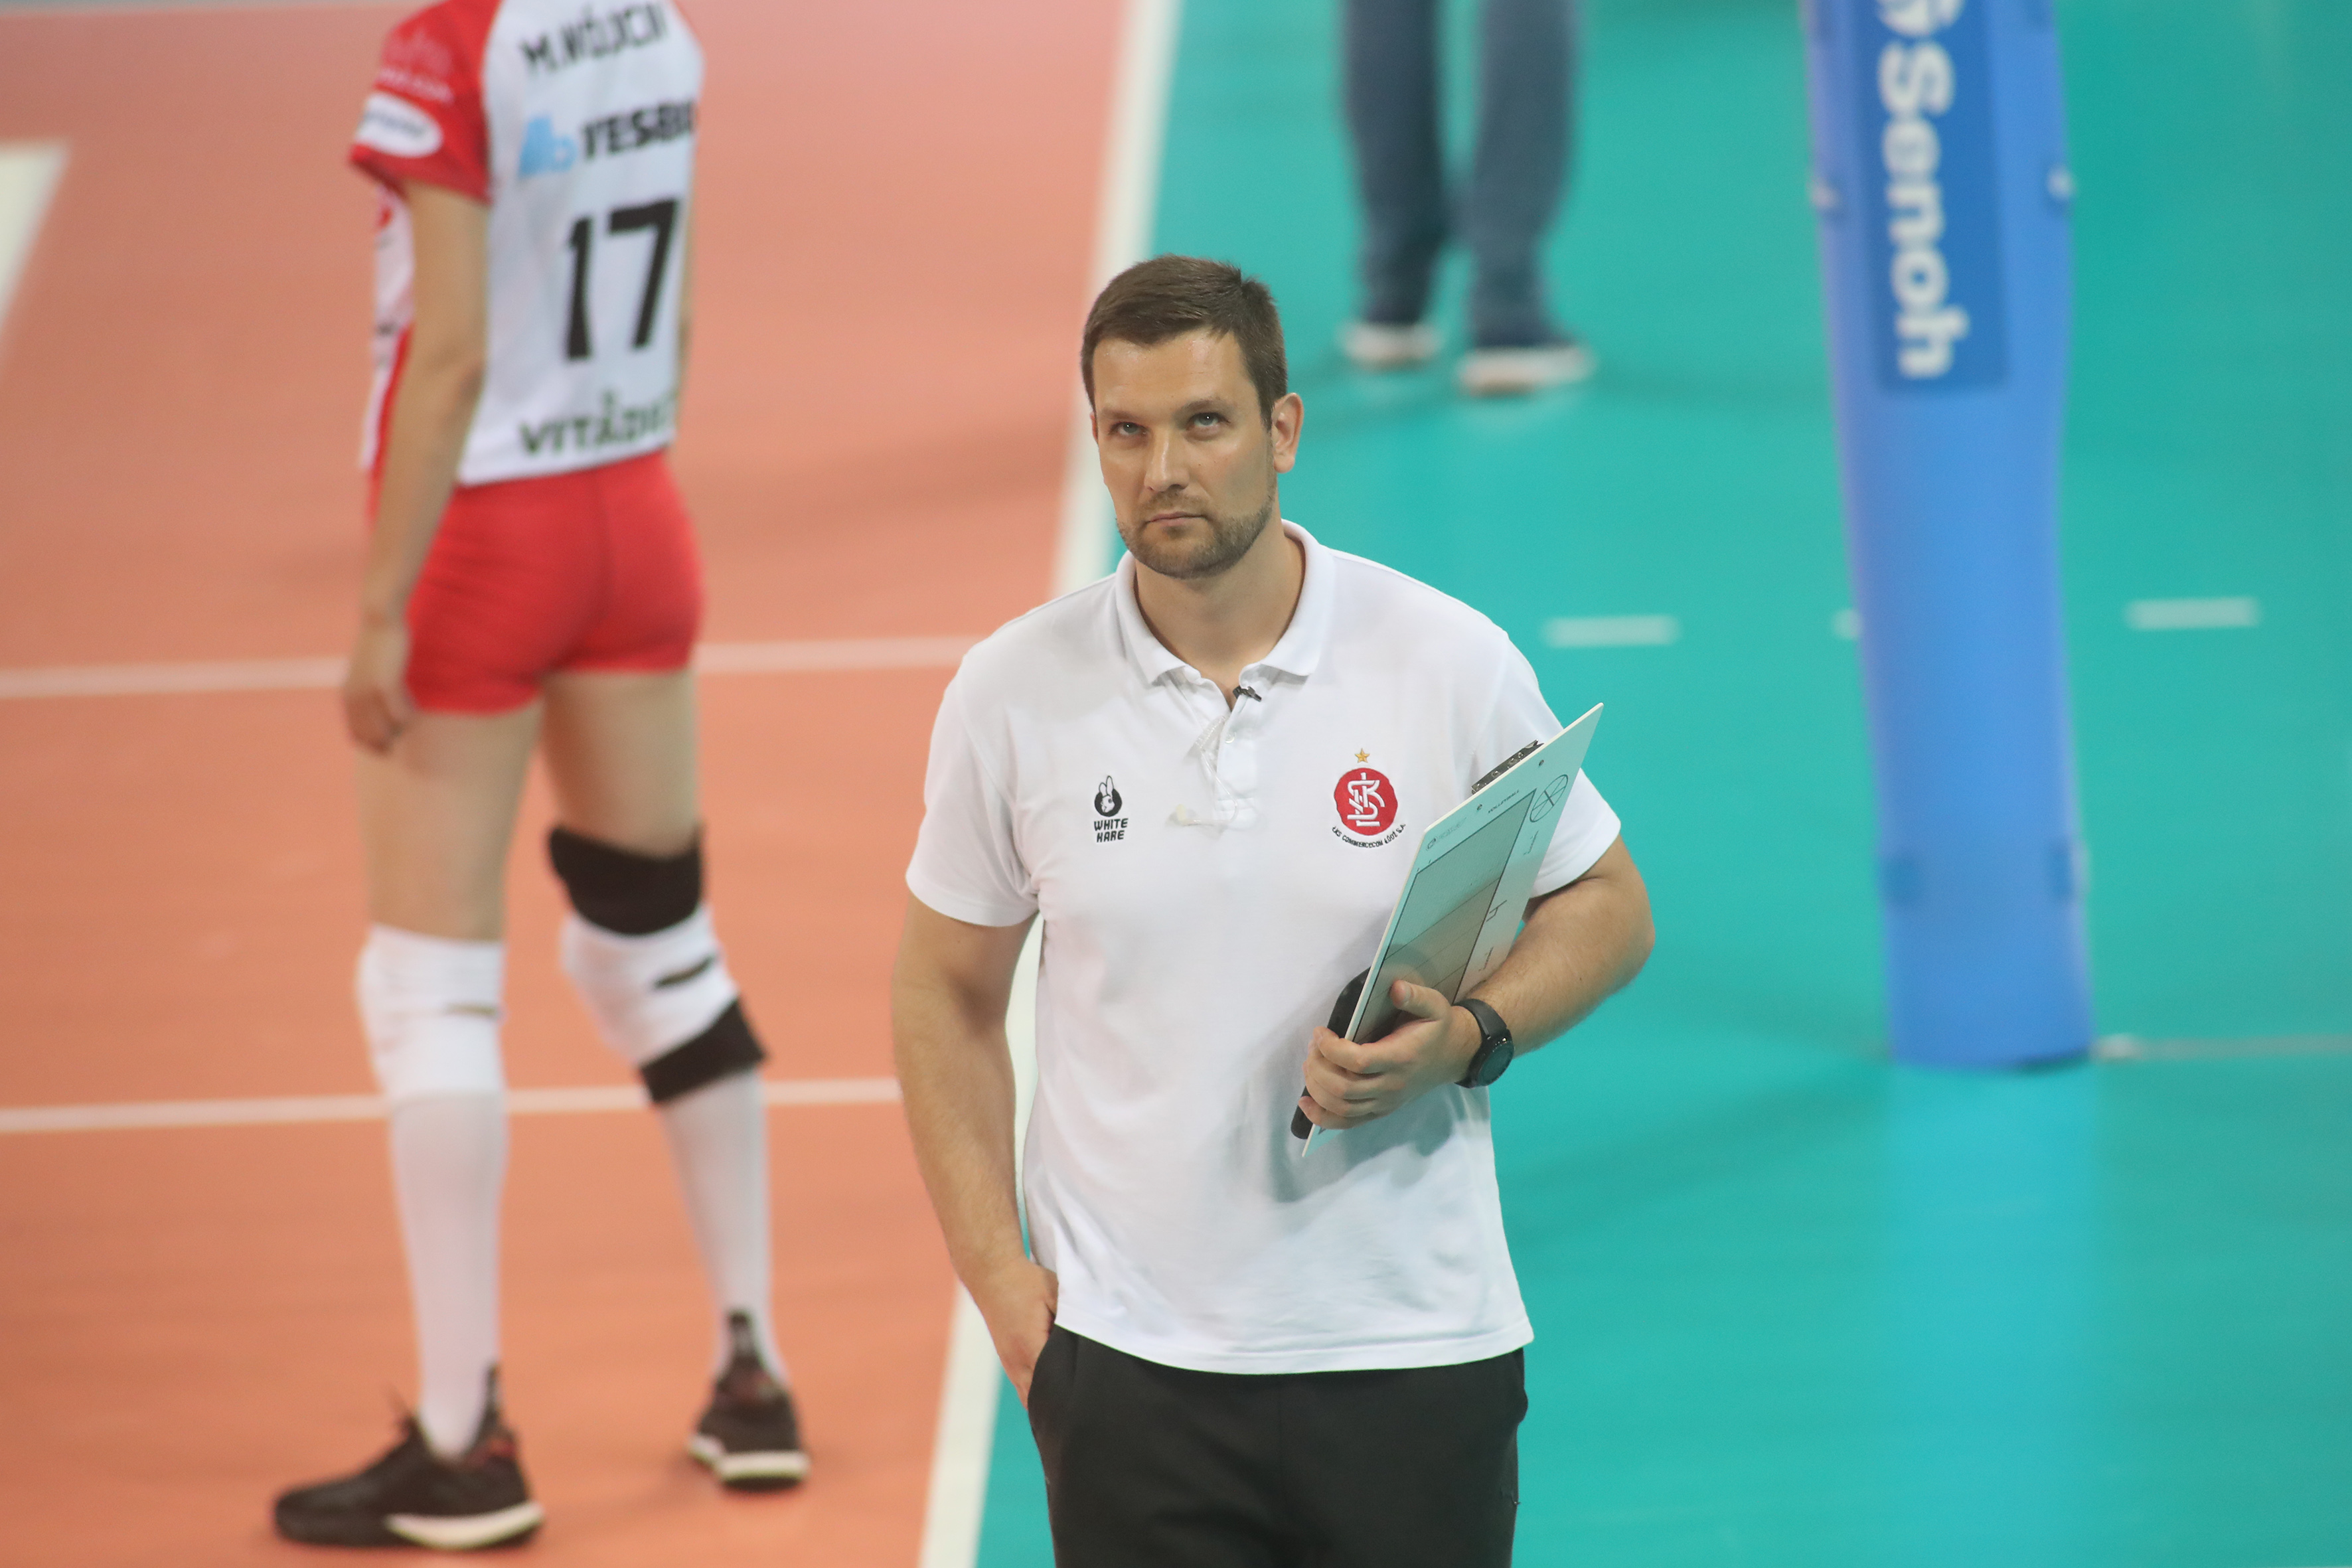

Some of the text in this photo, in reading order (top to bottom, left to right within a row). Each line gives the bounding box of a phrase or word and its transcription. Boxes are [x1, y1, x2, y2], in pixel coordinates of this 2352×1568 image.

[1876, 40, 1970, 378] Senoh
[566, 198, 679, 360] 17
[1488, 789, 1520, 814] VOLLEYBALL
[1094, 818, 1129, 831] WHITE
[1097, 830, 1125, 842] HARE
[1342, 834, 1383, 848] COMMERCECON
